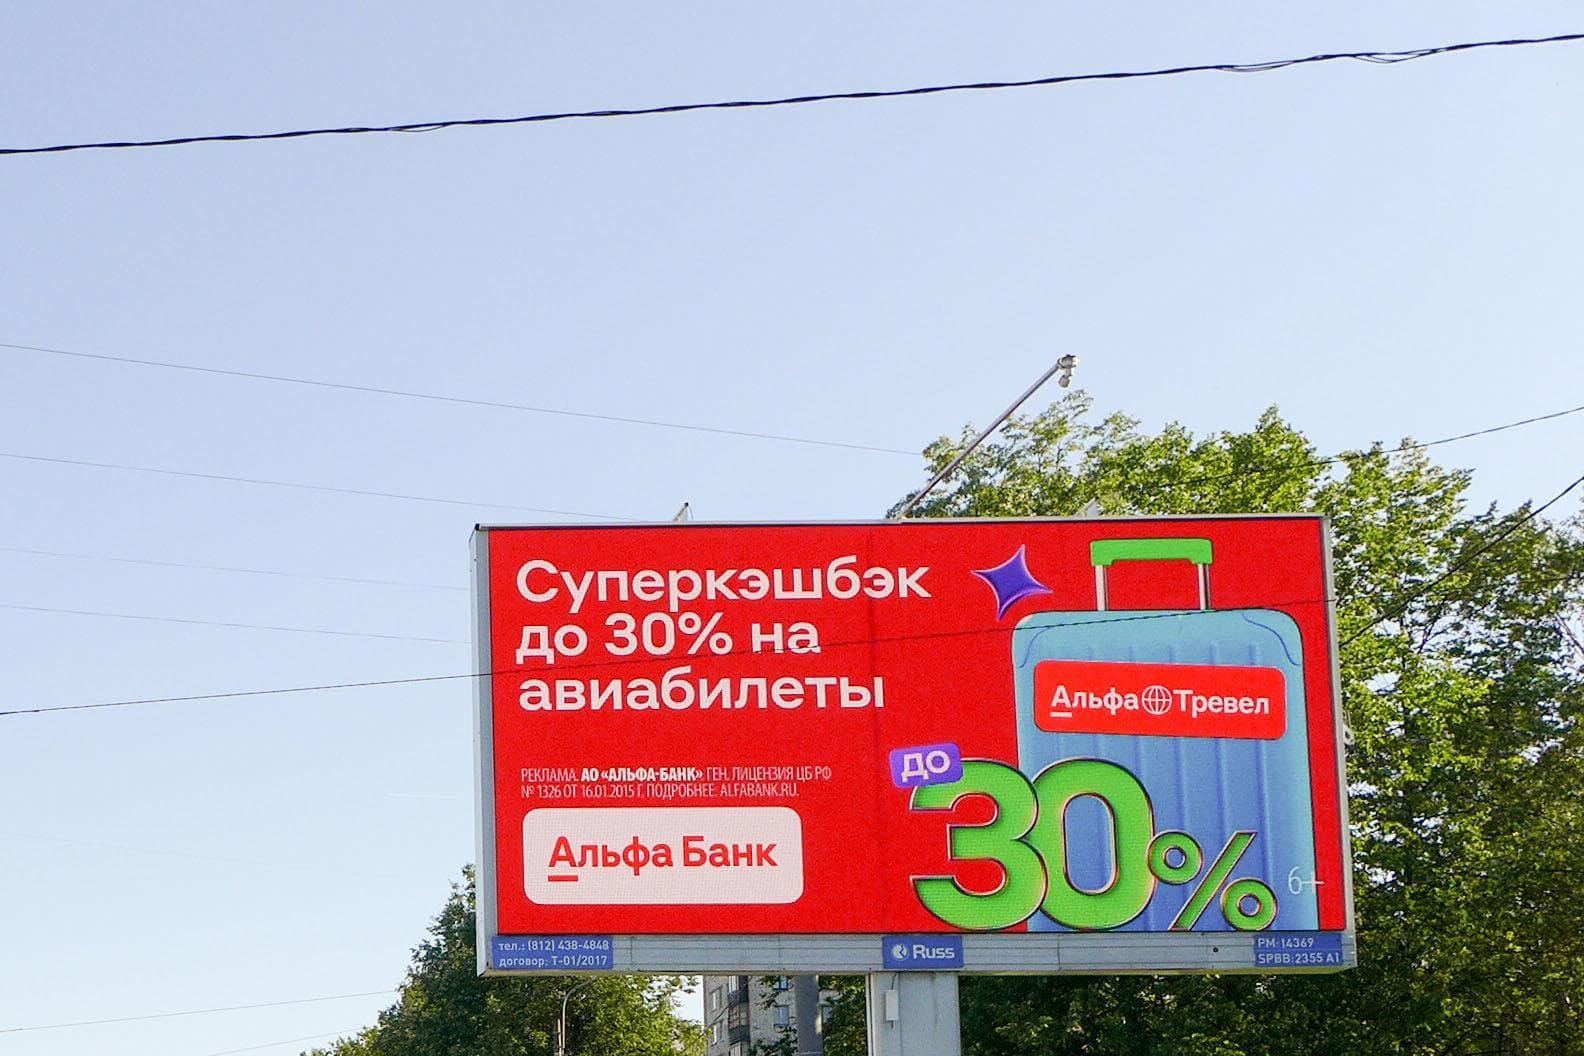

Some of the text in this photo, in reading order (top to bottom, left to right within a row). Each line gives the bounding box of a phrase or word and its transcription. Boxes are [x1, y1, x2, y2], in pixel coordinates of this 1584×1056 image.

[516, 554, 932, 614] Суперкэшбэк
[515, 612, 821, 665] до 30% на
[518, 665, 885, 711] авиабилеты
[1050, 685, 1270, 718] Альфа Тревел
[580, 767, 599, 782] АО
[600, 766, 704, 782] «АЛЬФА-БАНК»
[706, 766, 729, 781] ГЕН.
[731, 765, 794, 783] ЛИЦЕНЗИЯ
[796, 766, 813, 782] ЦБ
[814, 765, 832, 781] РФ
[521, 785, 535, 799] №
[537, 784, 562, 799] 1326
[563, 784, 578, 799] ОТ
[580, 784, 635, 799] 16.01.2015
[548, 834, 779, 877] Альфа Банк
[909, 757, 1279, 932] 30%
[1288, 866, 1325, 895] 6+
[527, 940, 555, 951] (812)
[557, 940, 609, 951] 438-4848
[912, 944, 955, 960] Russ
[499, 955, 608, 968] договор: Т-01/2017
